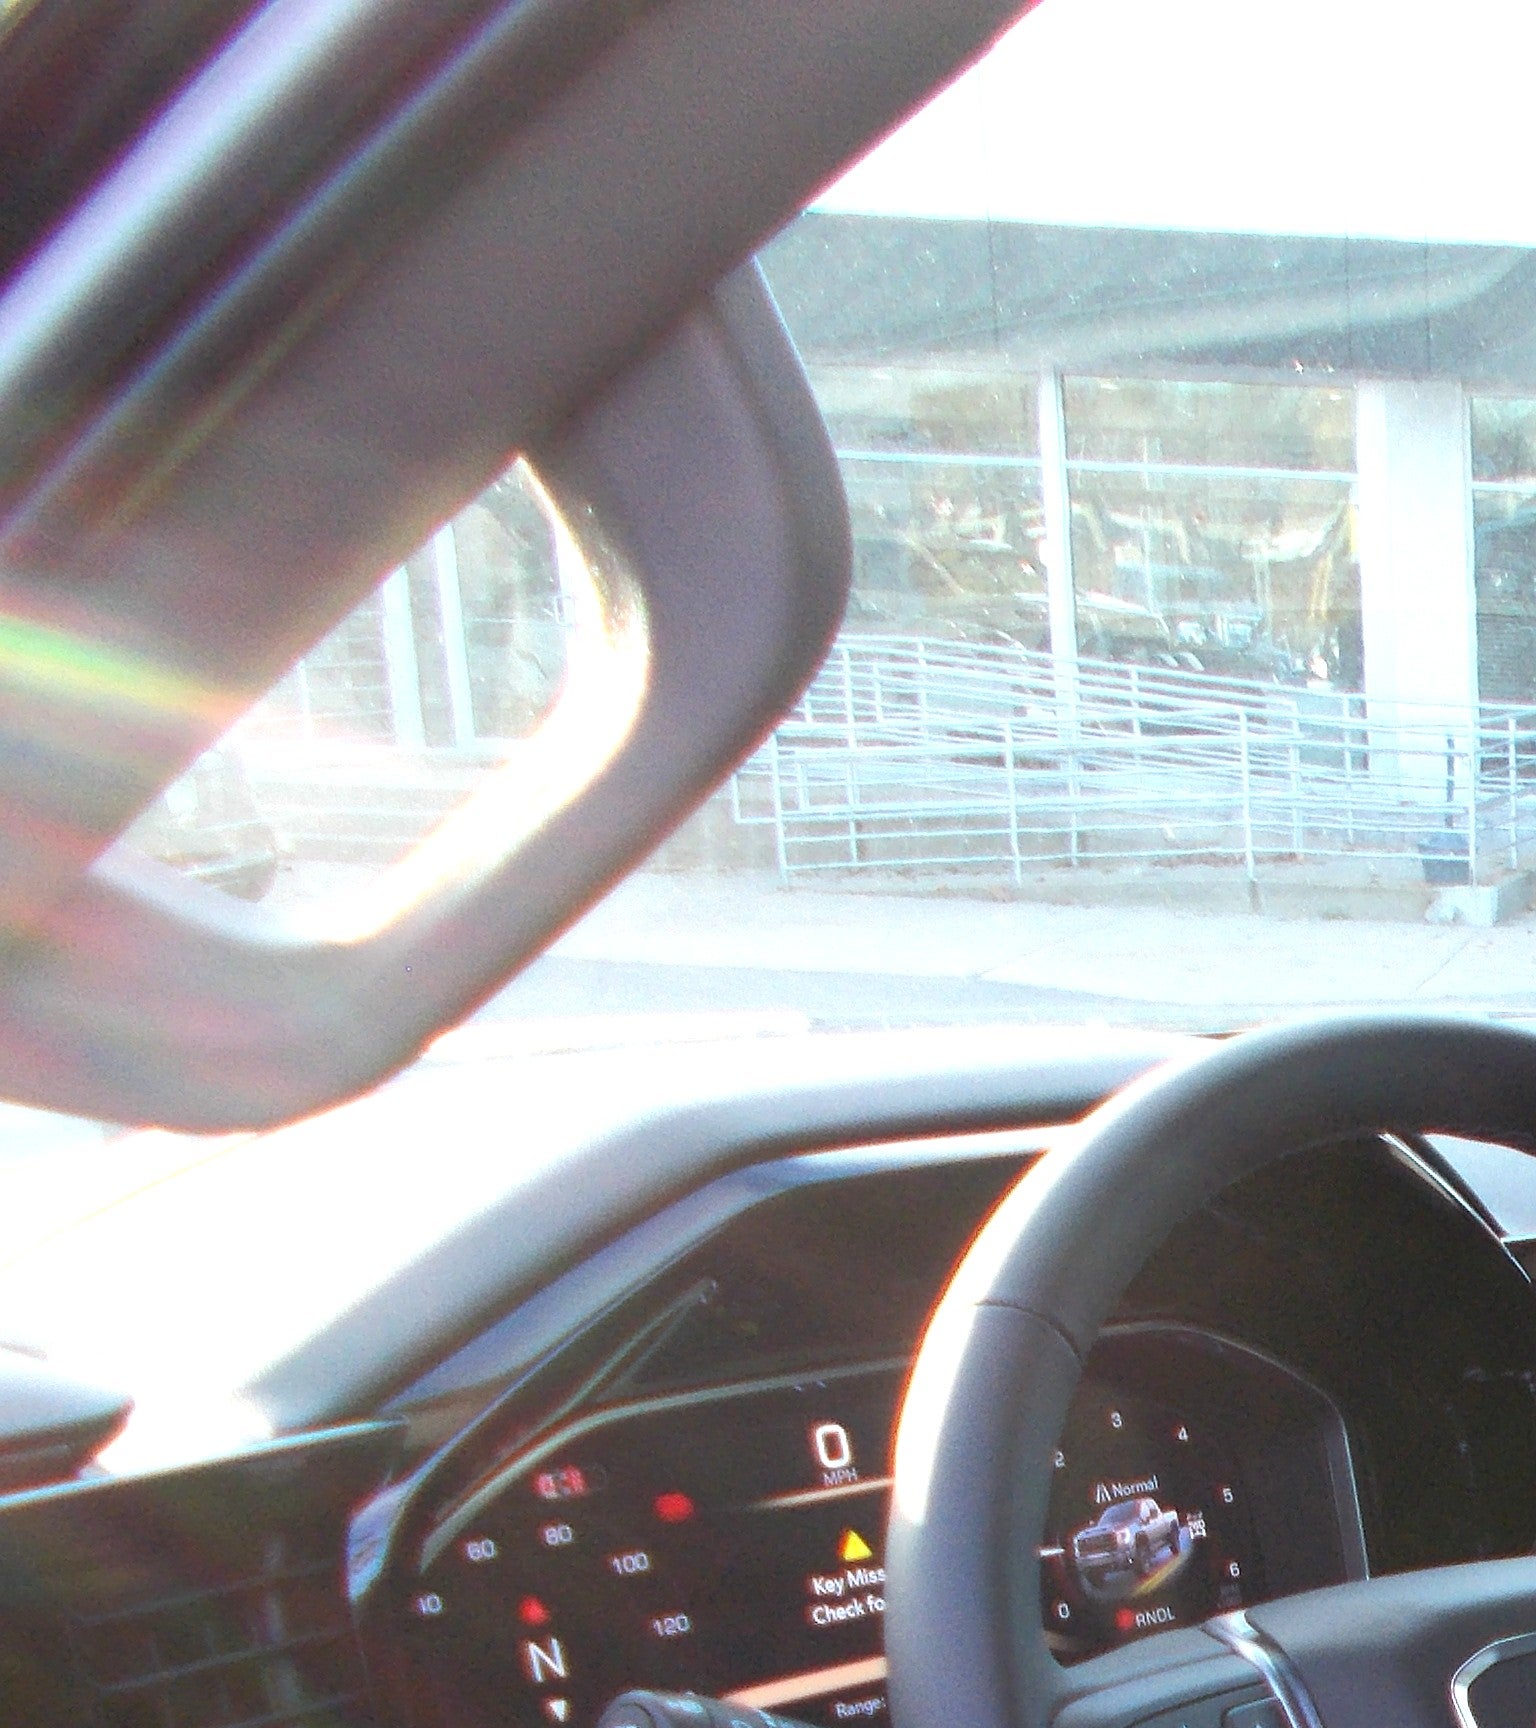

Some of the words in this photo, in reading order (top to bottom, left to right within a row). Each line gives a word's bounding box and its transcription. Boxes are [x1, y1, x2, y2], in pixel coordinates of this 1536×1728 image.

[1110, 1411, 1123, 1429] 3
[1177, 1426, 1189, 1442] 4
[815, 1424, 850, 1468] 0
[1111, 1474, 1160, 1498] Normal
[1222, 1487, 1234, 1504] 5
[612, 1552, 649, 1574] 100
[1229, 1562, 1240, 1577] 6
[811, 1576, 845, 1597] Key
[811, 1598, 865, 1625] Check
[653, 1613, 691, 1637] 120
[526, 1637, 568, 1683] N
